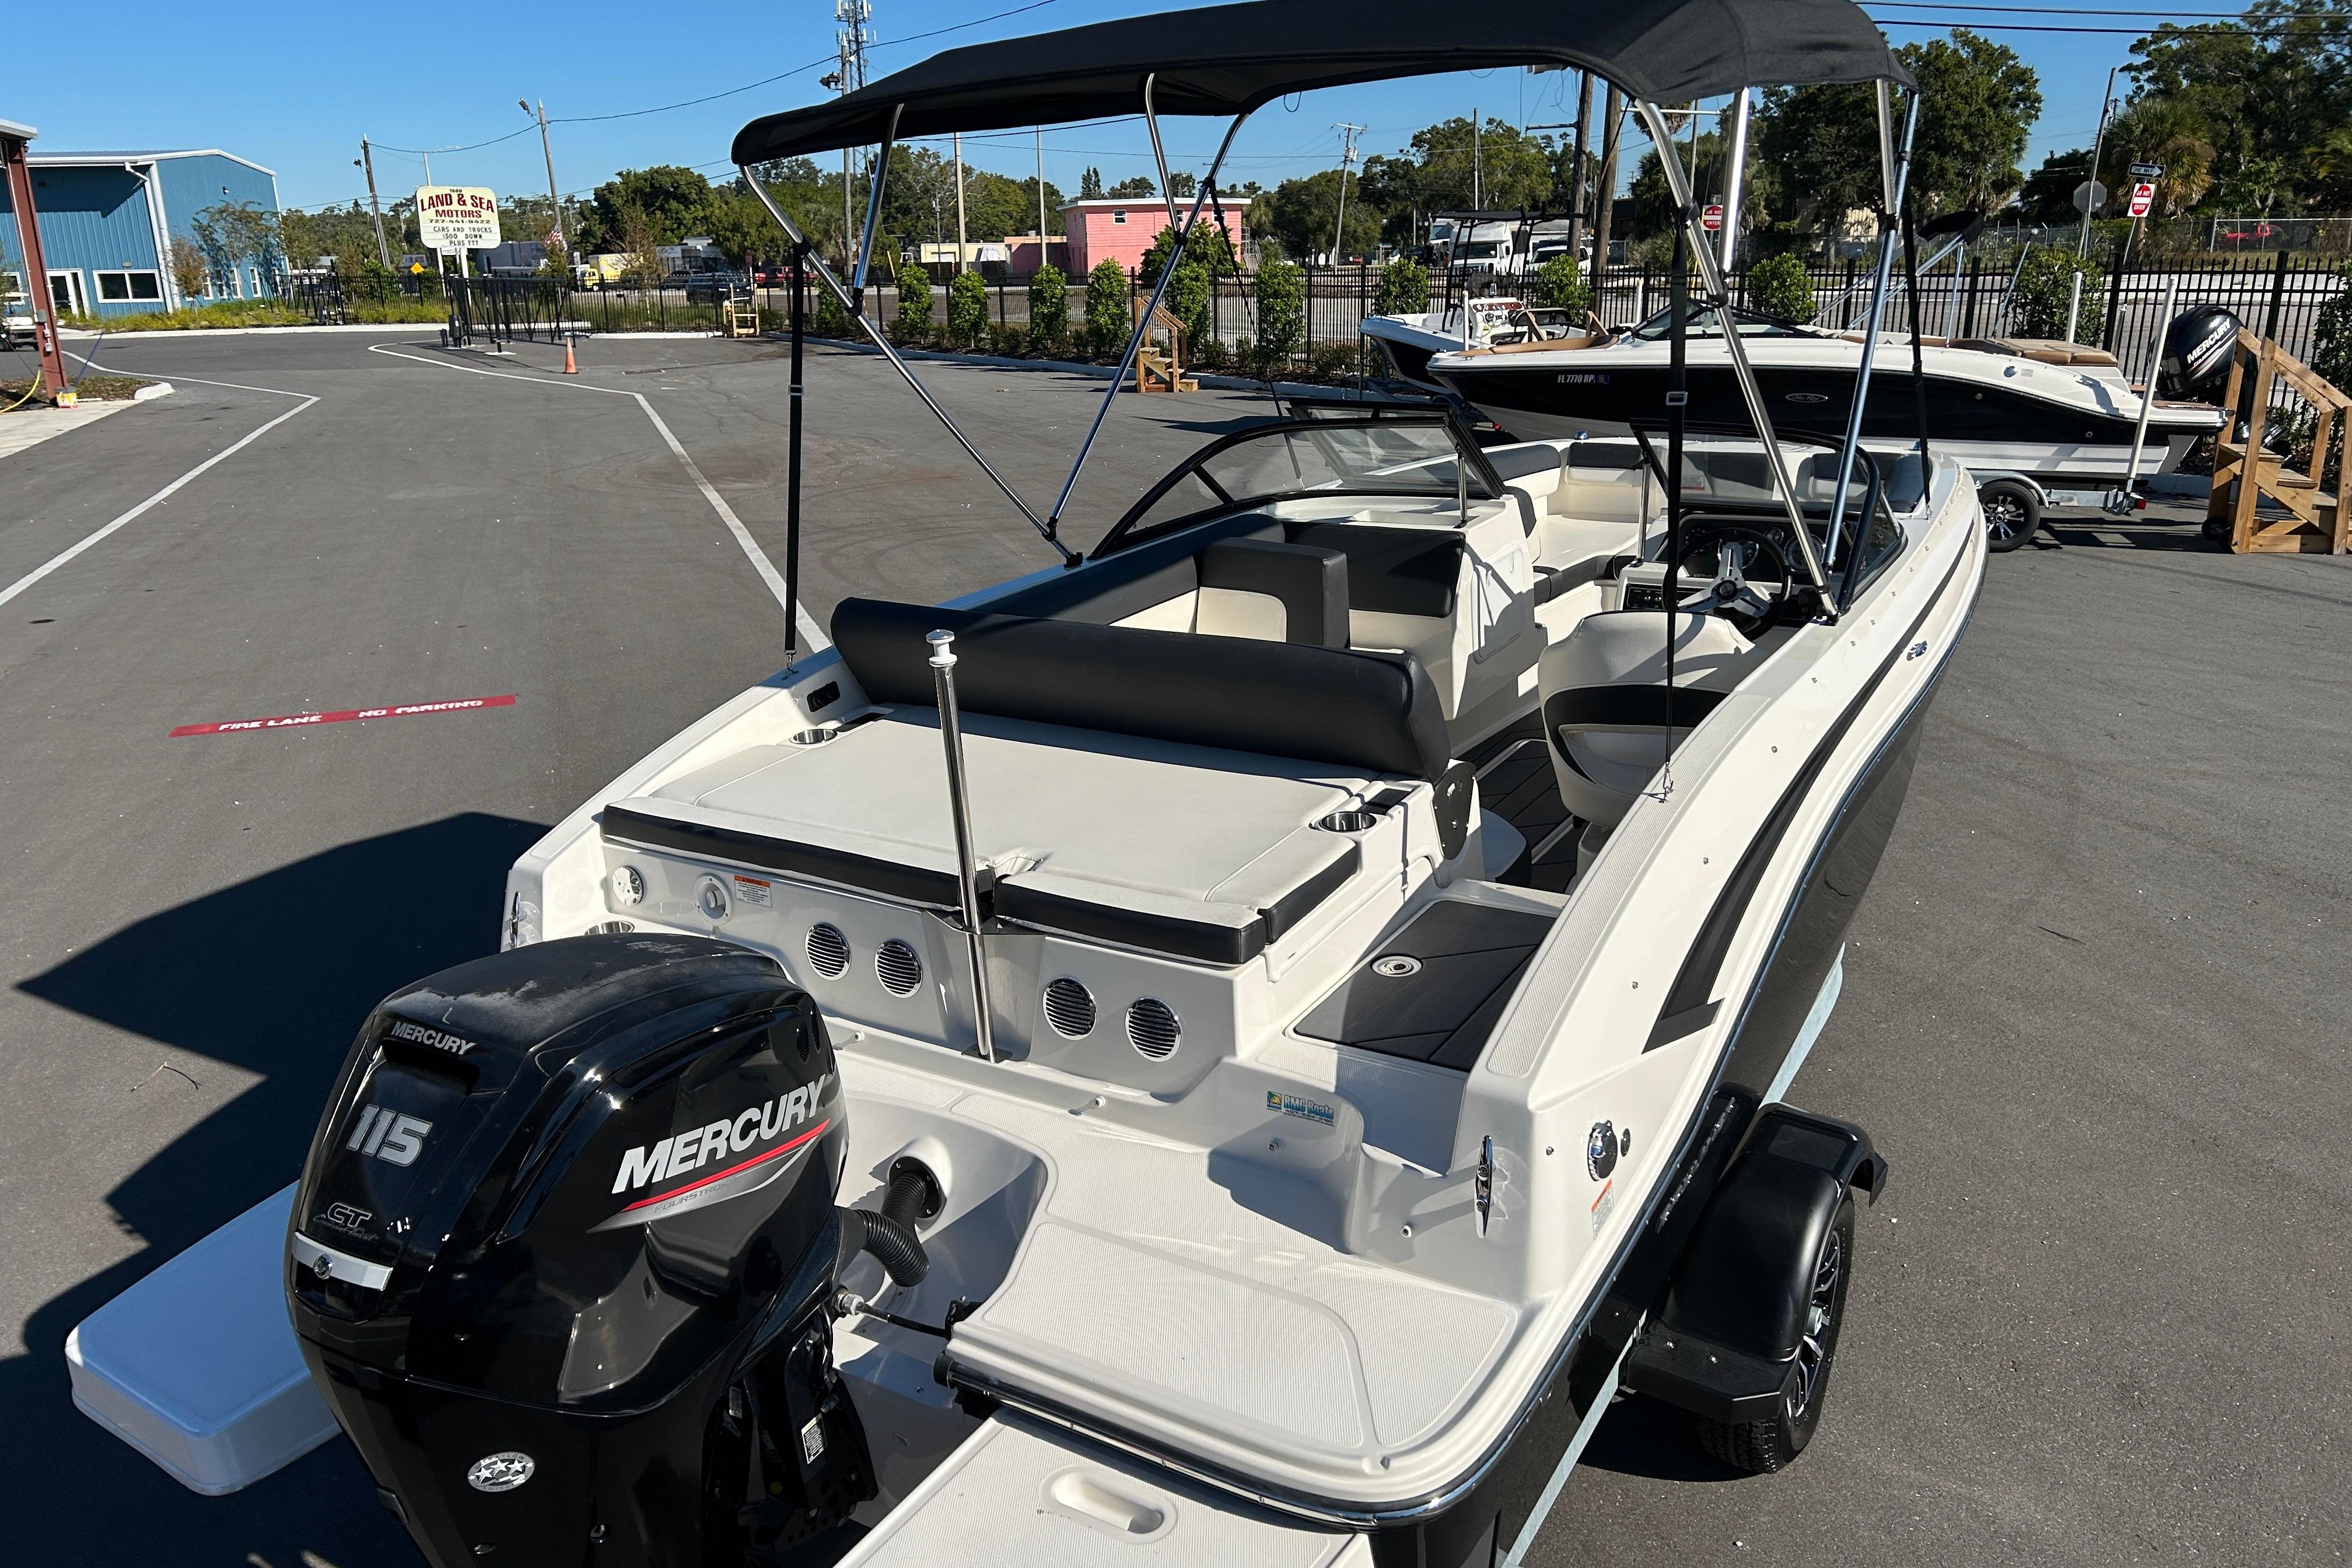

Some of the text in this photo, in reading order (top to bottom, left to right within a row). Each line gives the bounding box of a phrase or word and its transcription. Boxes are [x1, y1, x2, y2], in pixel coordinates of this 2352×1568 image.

[420, 193, 495, 213] LAND & SEA
[435, 209, 481, 218] MOTORS
[2186, 317, 2231, 364] MERCURY
[1558, 374, 1564, 383] FL
[1566, 374, 1583, 383] 7770
[1584, 374, 1594, 383] RP
[219, 700, 483, 732] FIRE LANE NO PARKING
[391, 1021, 476, 1055] MERCURY
[1284, 1094, 1307, 1112] BMC
[1307, 1100, 1334, 1121] Boats
[346, 1104, 433, 1167] 115
[611, 1073, 826, 1194] MERCURY
[653, 1177, 735, 1213] FOURSTROKE
